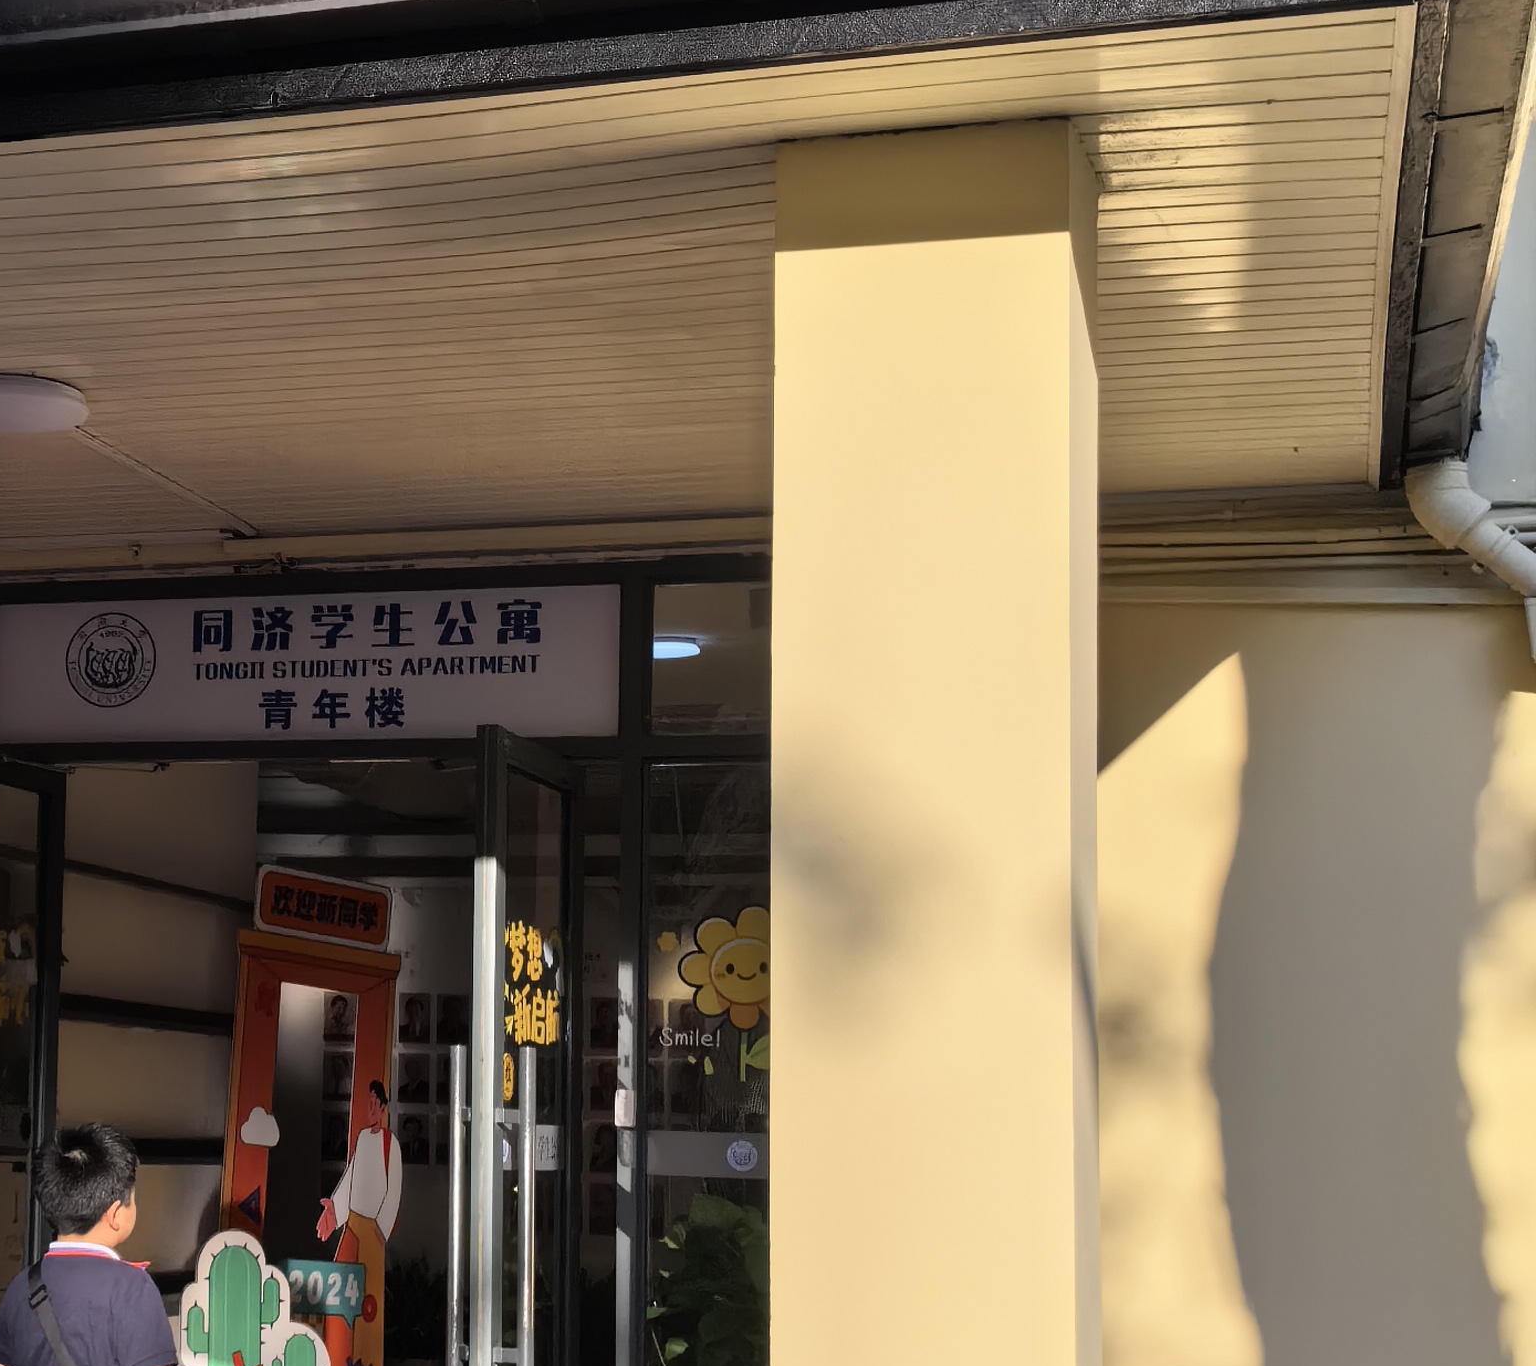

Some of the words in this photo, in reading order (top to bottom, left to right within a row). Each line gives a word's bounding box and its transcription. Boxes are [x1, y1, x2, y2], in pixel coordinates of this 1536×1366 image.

[193, 599, 542, 653] 同济学生公寓
[272, 657, 392, 679] STUDENT'S
[400, 654, 540, 676] APARTMENT
[259, 687, 405, 730] 青年楼
[271, 886, 379, 931] 欢迎新同学
[659, 1027, 720, 1048] Smile!
[289, 1269, 359, 1307] 2024
